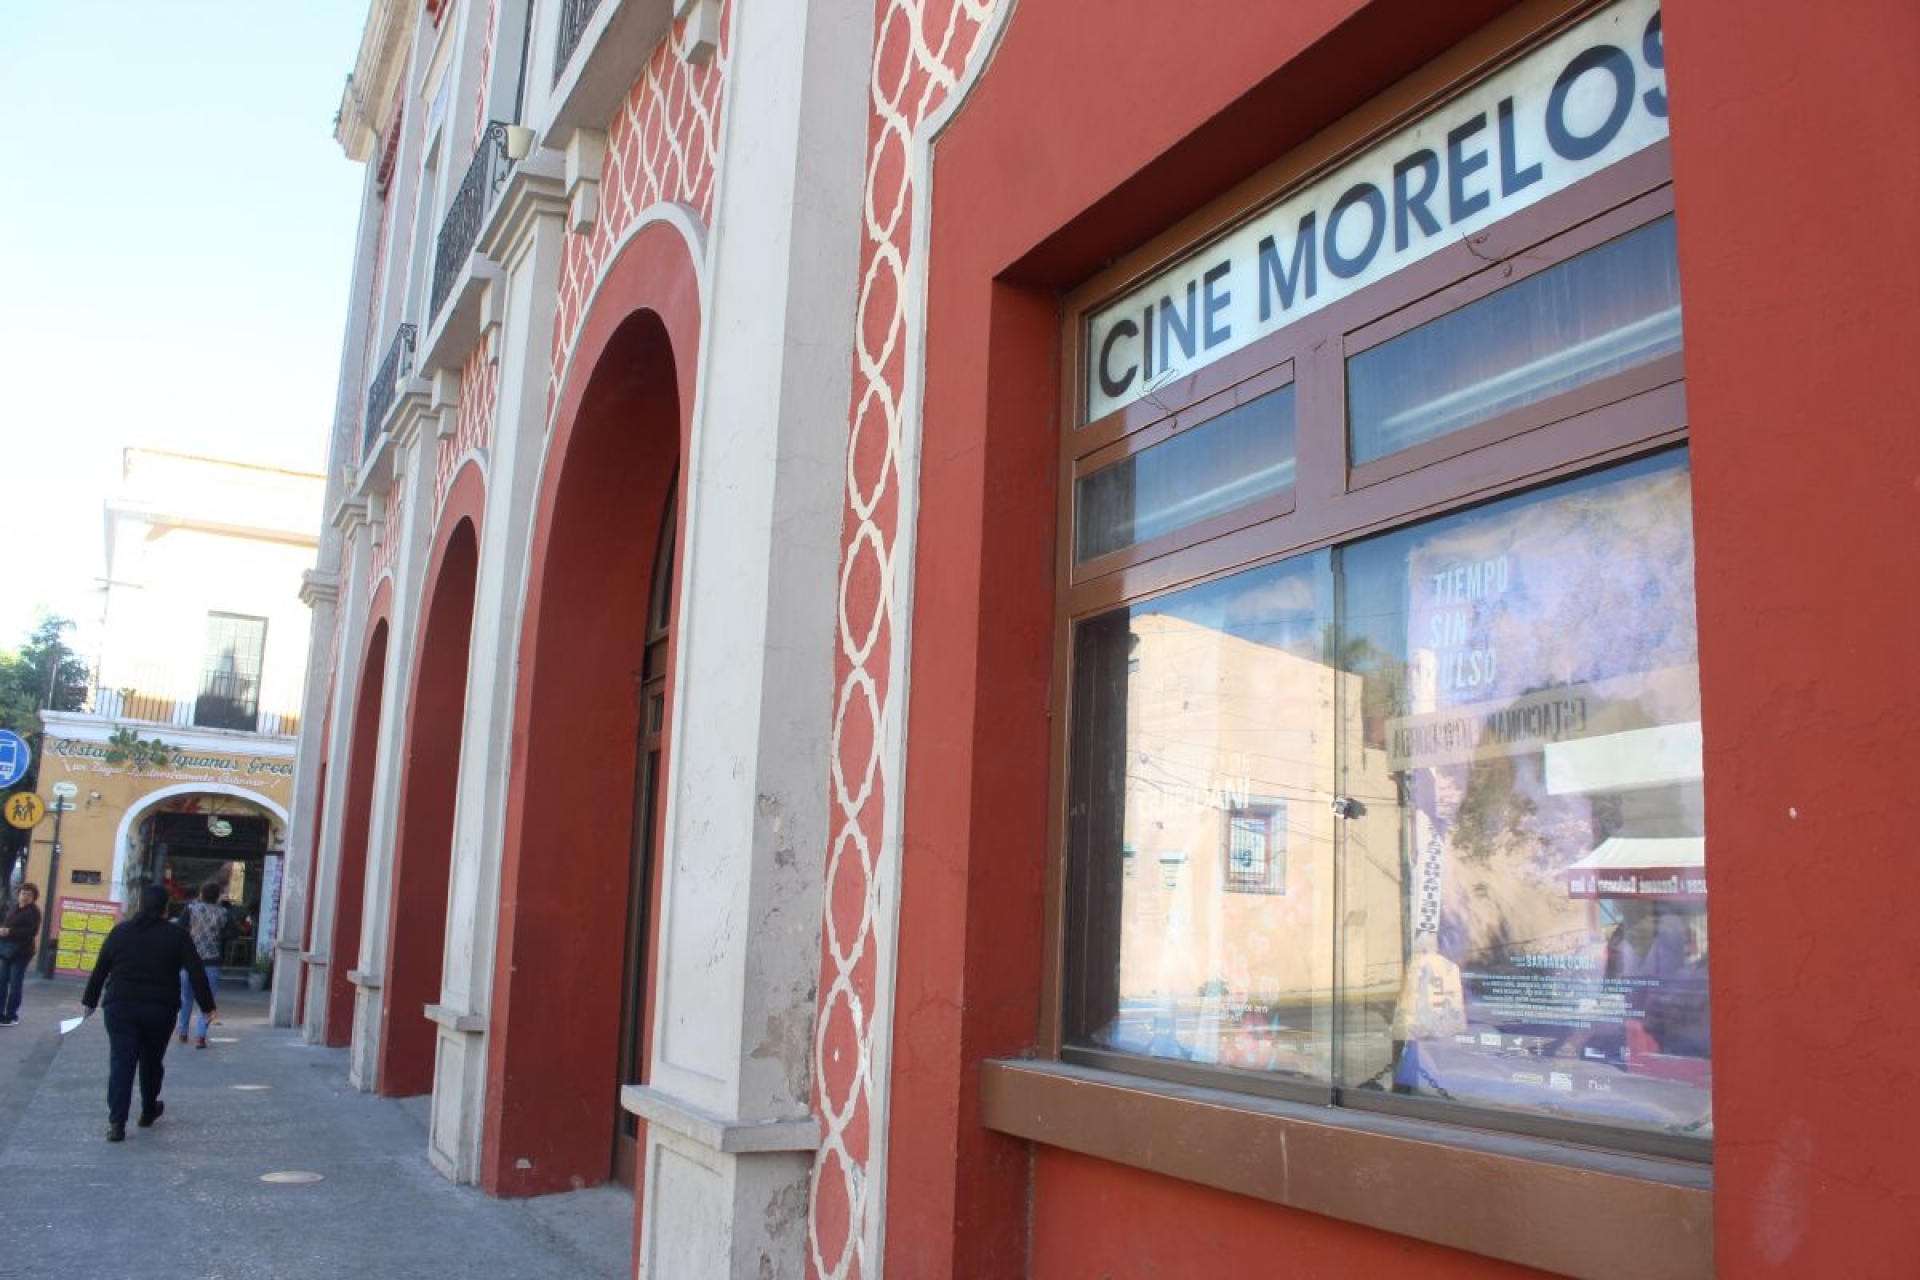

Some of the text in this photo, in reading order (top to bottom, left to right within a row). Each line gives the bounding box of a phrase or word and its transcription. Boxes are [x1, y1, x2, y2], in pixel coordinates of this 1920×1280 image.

[1099, 260, 1232, 399] CINE
[1433, 557, 1509, 603] TIEMPO
[1430, 611, 1467, 648] SIN
[1431, 648, 1497, 690] ULSO
